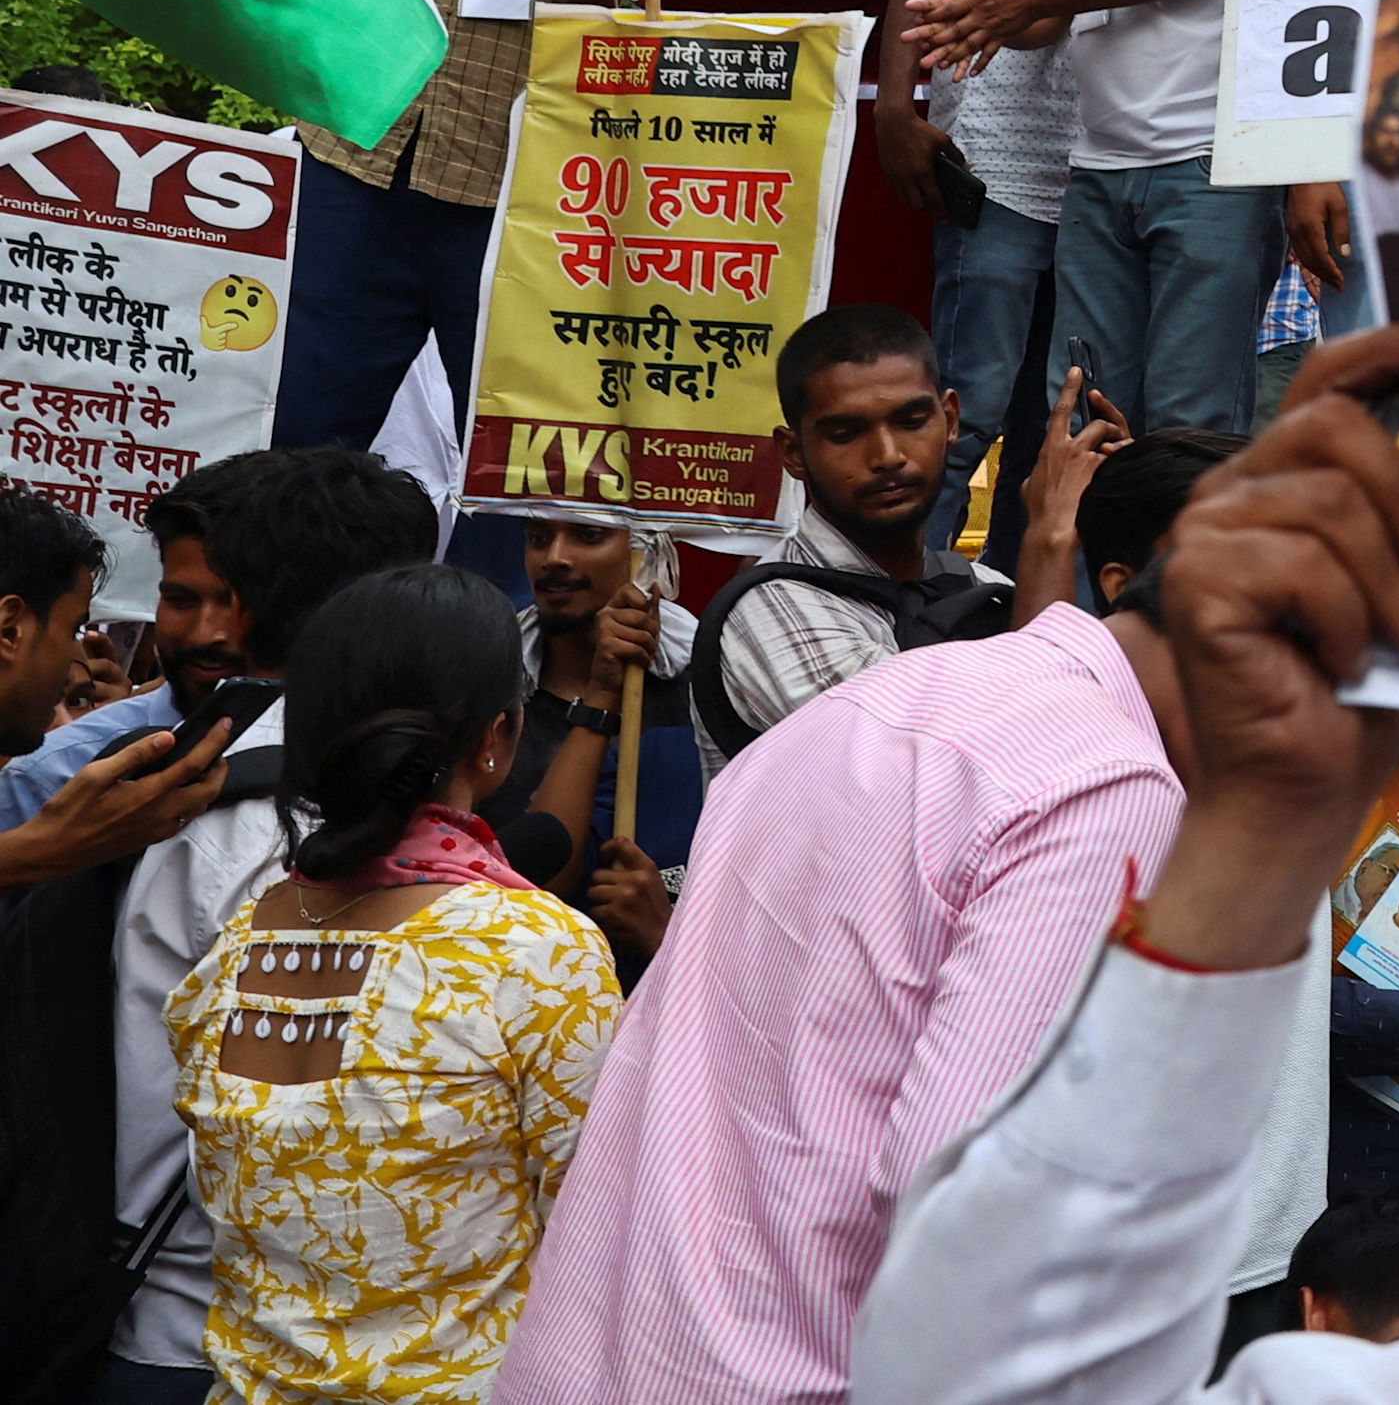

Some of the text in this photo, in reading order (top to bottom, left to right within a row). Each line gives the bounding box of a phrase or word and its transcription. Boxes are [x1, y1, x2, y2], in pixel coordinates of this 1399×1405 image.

[584, 62, 650, 88] लीक नहीं,
[587, 40, 656, 63] सिर्फ पेपर
[663, 40, 788, 70] मोदी राज में हो
[1281, 4, 1363, 99] a
[659, 64, 788, 91] रहा टैलेंट लीक!
[589, 108, 777, 145] पिछले 10 साल में
[557, 154, 793, 229] 90 हजार
[0, 196, 227, 244] rantikari Yuva Sangathan
[6, 232, 120, 281] लीक के
[554, 214, 782, 303] से ज्यादा
[38, 278, 71, 317] से
[75, 286, 170, 332] परीक्षा
[17, 326, 123, 364] अपराध
[126, 328, 152, 374] है
[156, 337, 197, 382] तो,
[550, 305, 773, 370] सरकारी स्कूल
[597, 350, 718, 407] हुए बंद!
[30, 381, 135, 432] स्कूलों
[138, 386, 176, 430] के
[7, 417, 201, 479] शिक्षा बेचना
[504, 423, 632, 504] KYS
[642, 436, 756, 463] Krantikari
[678, 460, 730, 484] Yuva
[632, 480, 756, 510] Sangathan
